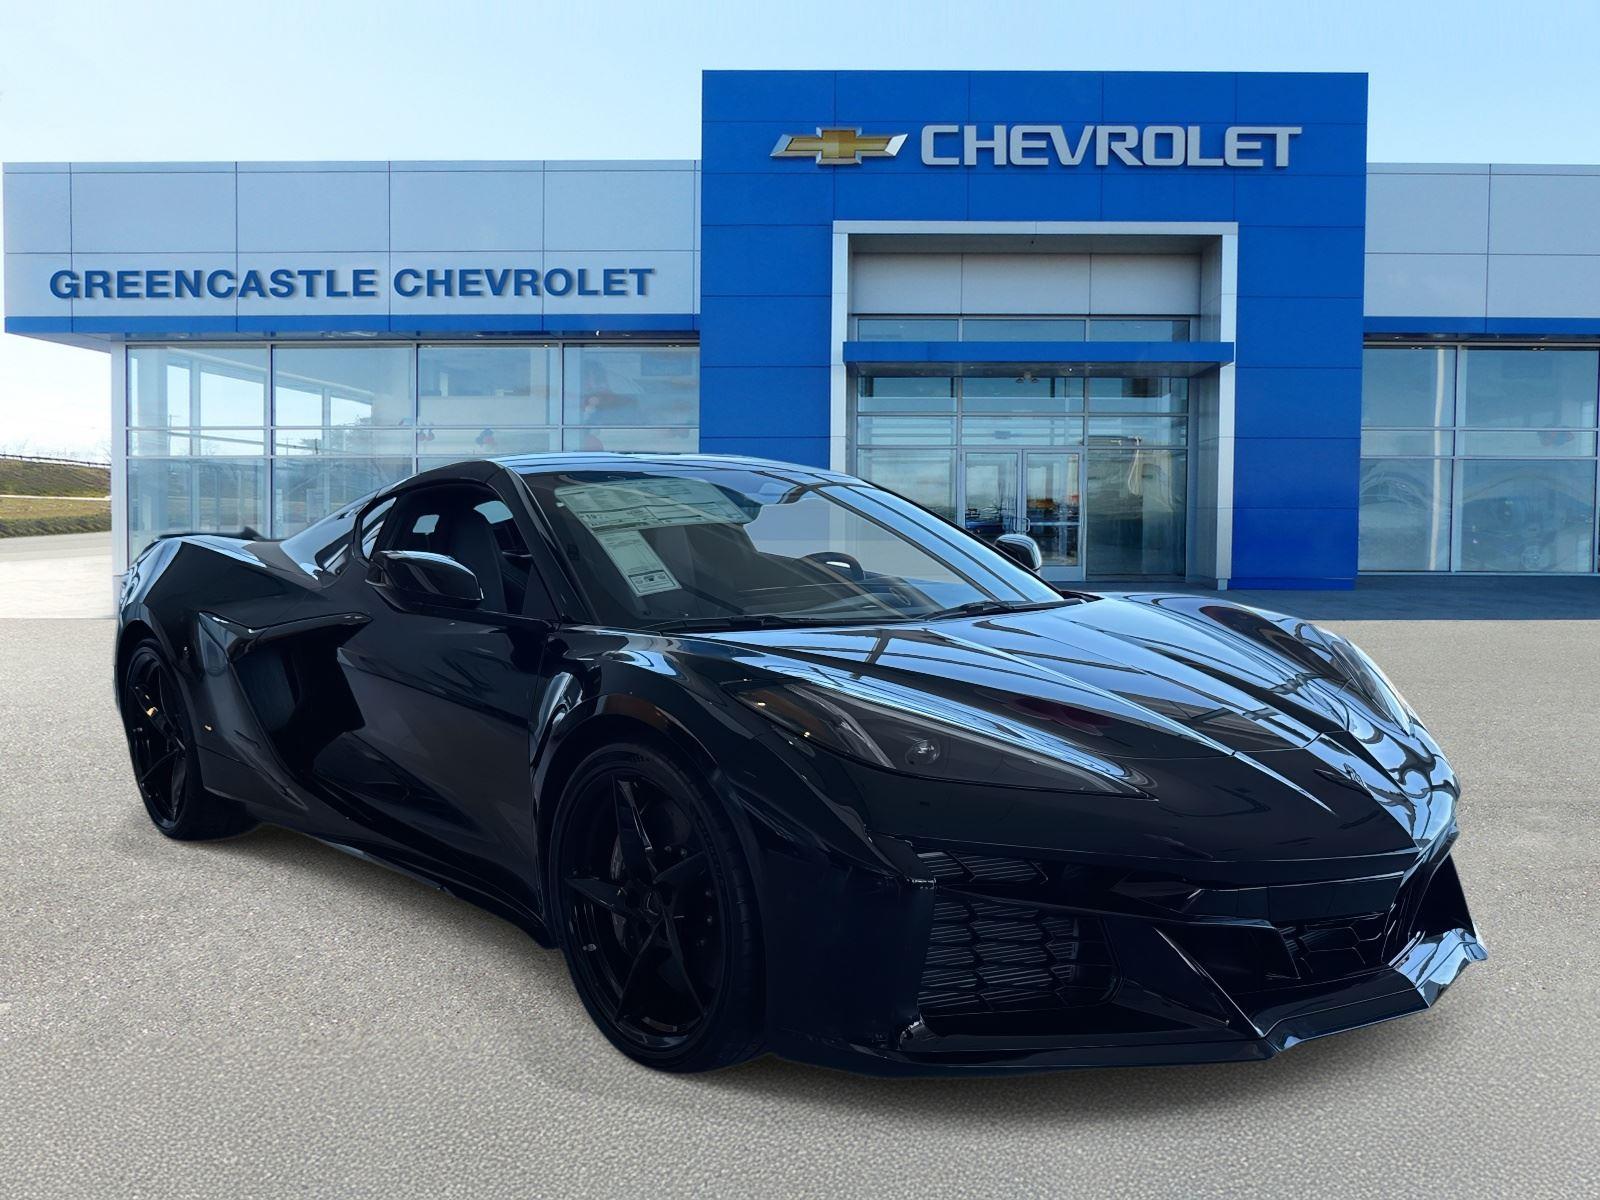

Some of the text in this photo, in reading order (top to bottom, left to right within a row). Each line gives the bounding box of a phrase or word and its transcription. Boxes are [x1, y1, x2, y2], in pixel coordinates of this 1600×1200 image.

[921, 125, 1302, 167] CHEVROLET
[50, 268, 655, 299] GREENCASTLE CHEVROLET
